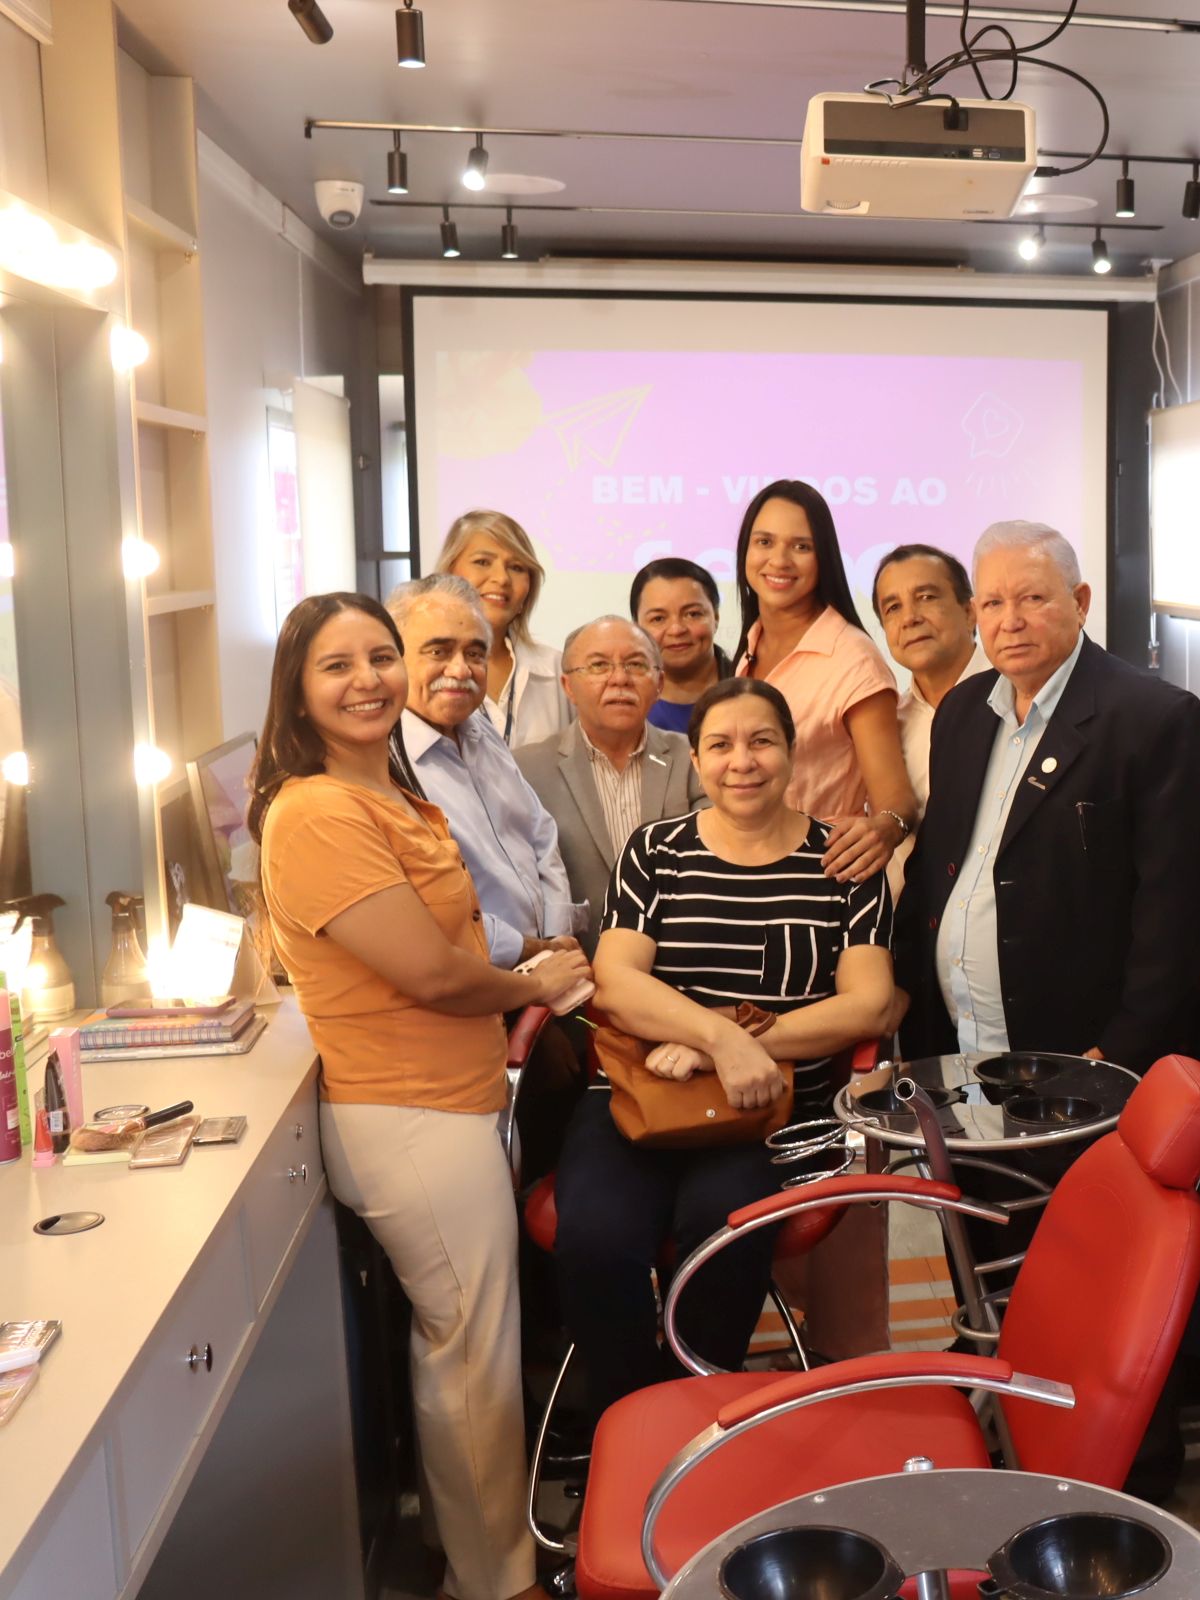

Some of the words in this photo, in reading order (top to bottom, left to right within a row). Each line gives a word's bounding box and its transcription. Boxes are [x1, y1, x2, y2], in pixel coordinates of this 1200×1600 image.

[593, 476, 683, 504] BEM
[722, 475, 879, 505] VIOS
[891, 477, 947, 506] AO
